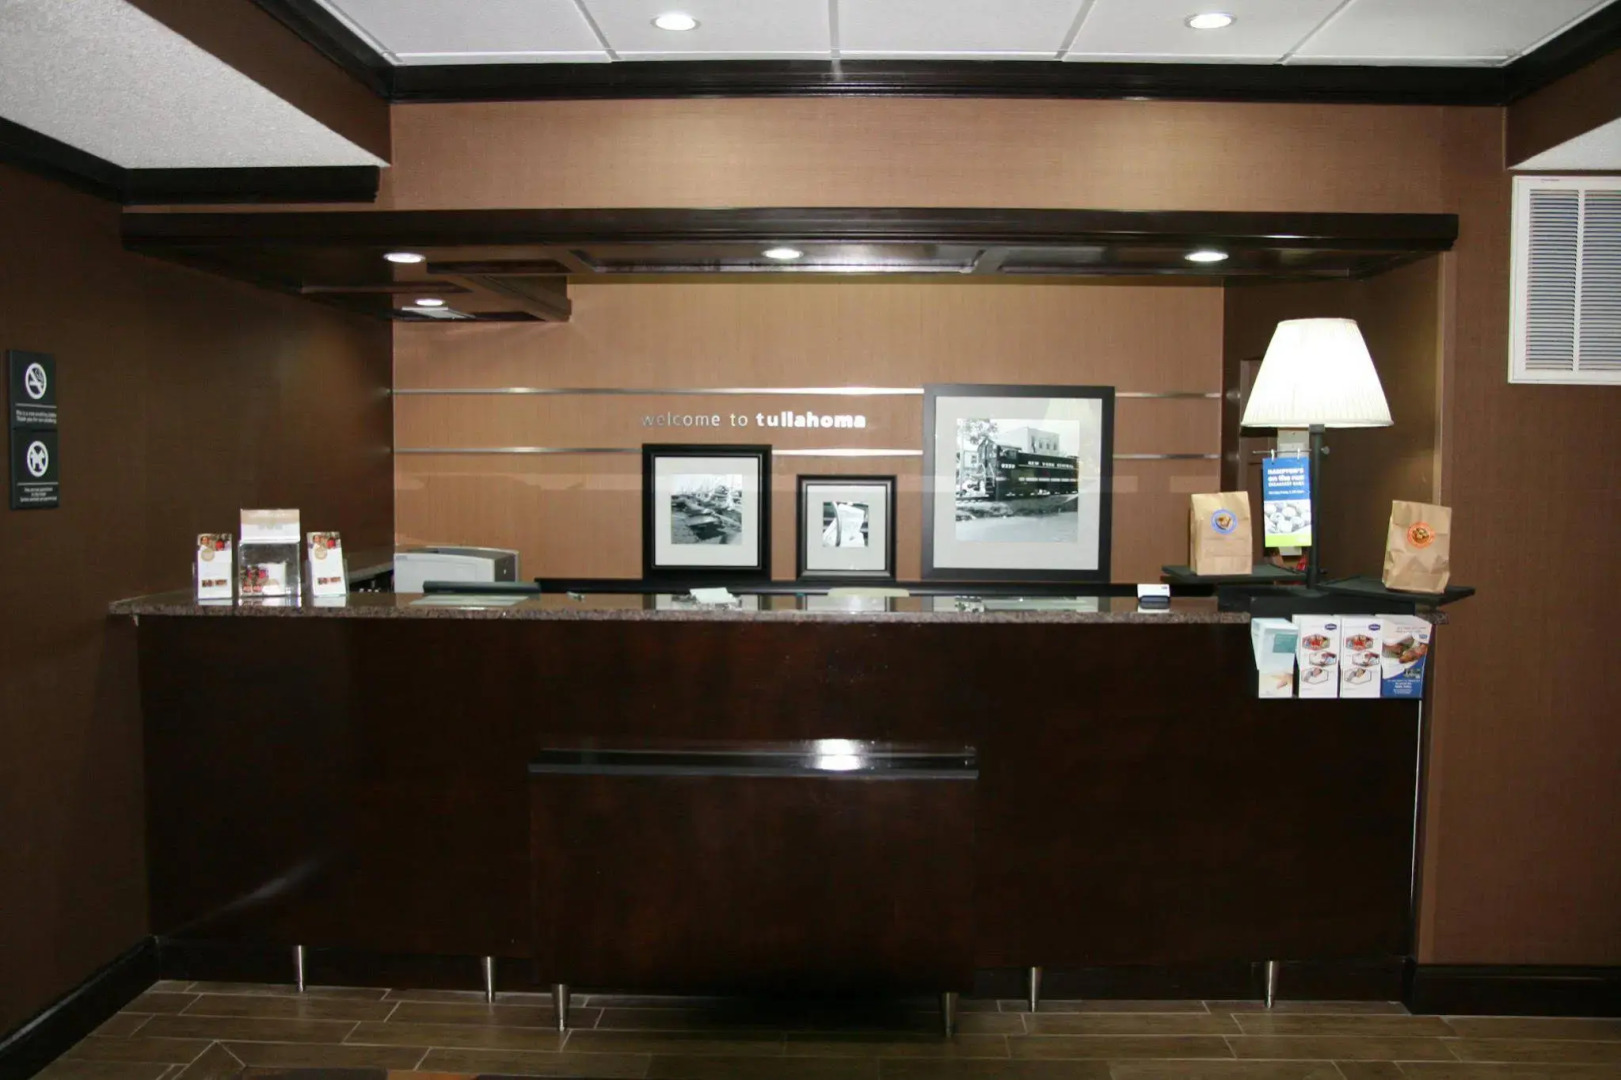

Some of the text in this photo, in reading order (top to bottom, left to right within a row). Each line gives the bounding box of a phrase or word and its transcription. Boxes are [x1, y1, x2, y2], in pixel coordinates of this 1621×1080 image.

[642, 411, 867, 428] welcome to tullahoma
